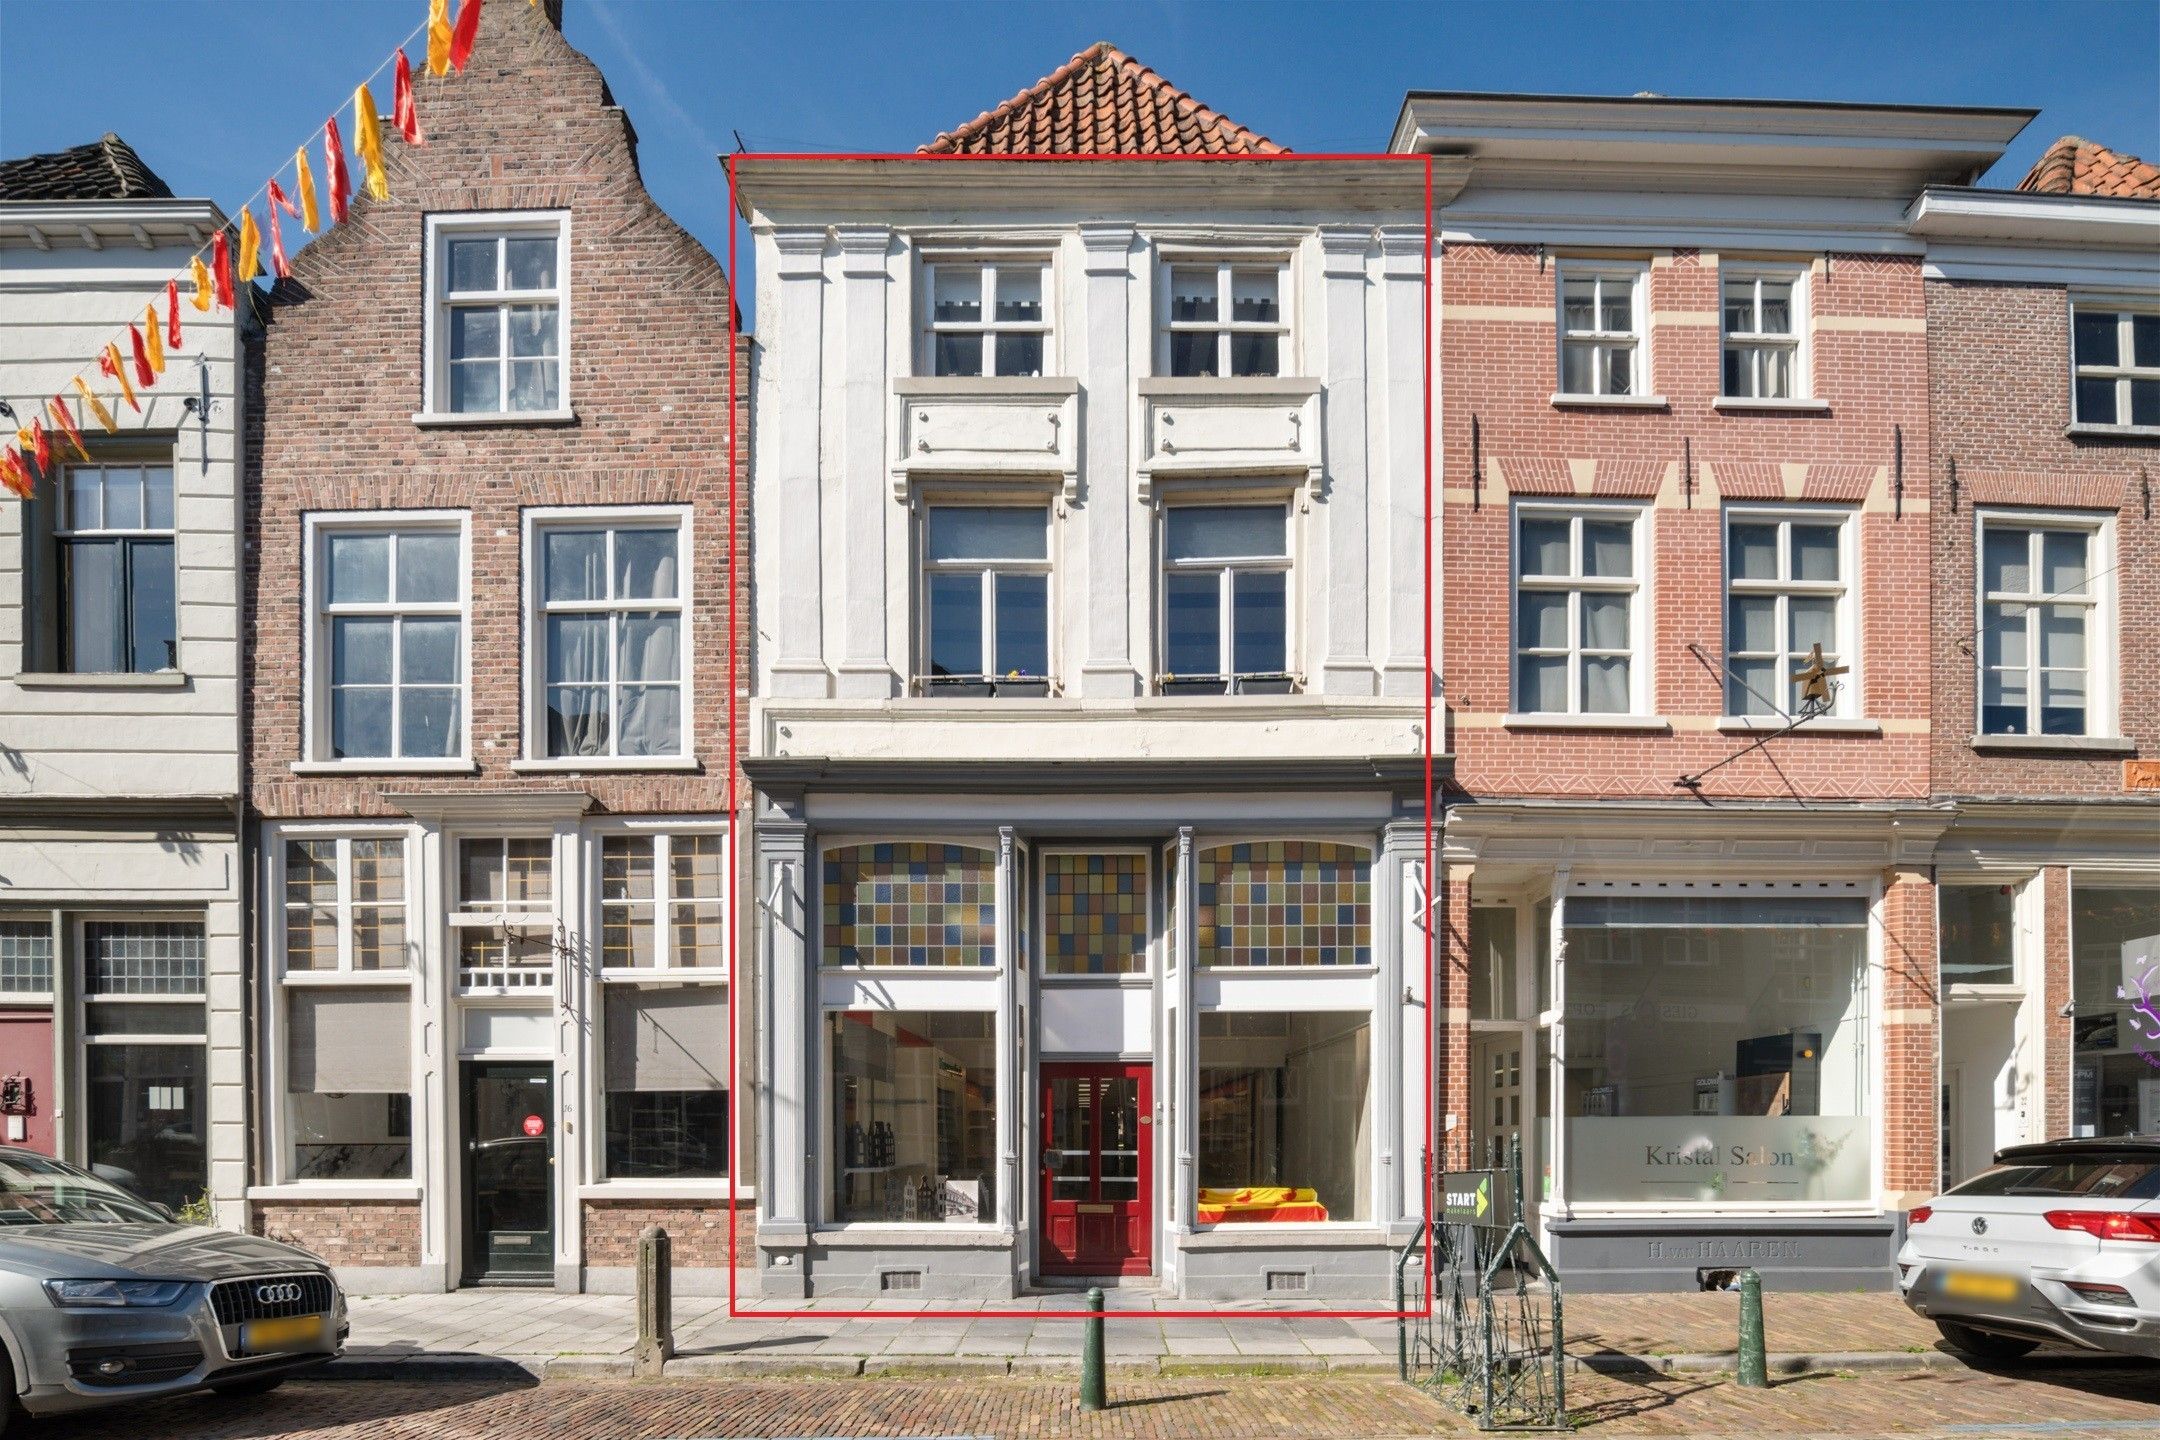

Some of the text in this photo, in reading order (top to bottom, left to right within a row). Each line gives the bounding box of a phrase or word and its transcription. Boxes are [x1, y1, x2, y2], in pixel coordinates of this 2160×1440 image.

[1645, 1145, 1794, 1166] Kristal Salon
[1446, 1192, 1476, 1206] START
